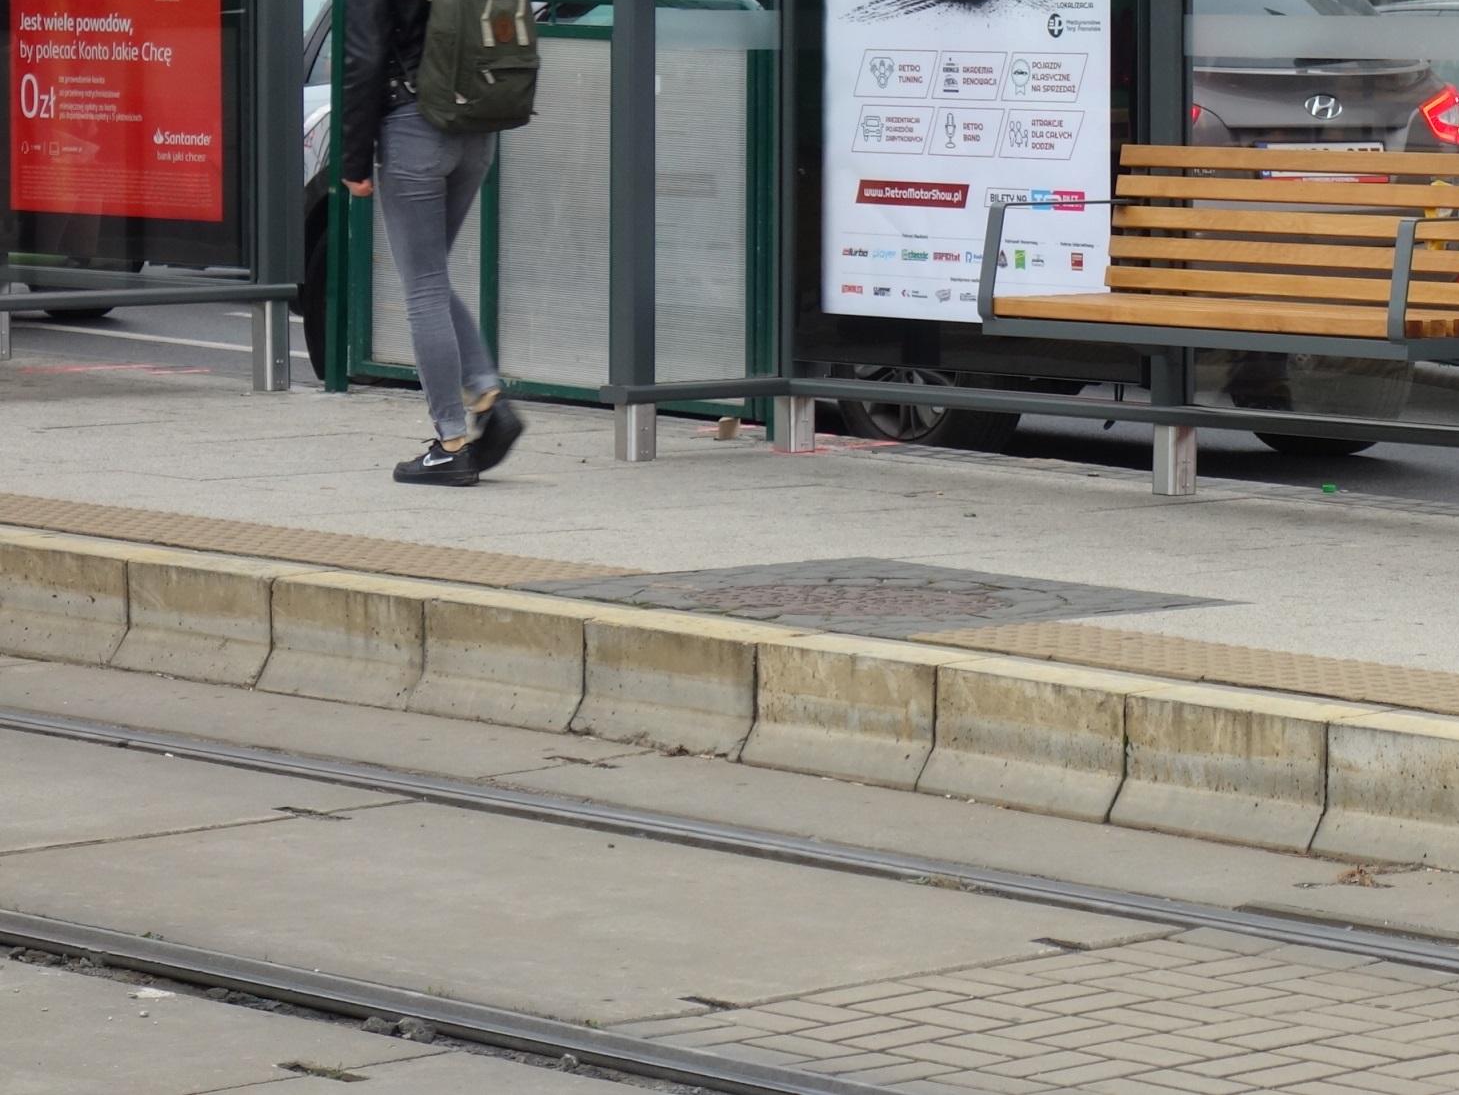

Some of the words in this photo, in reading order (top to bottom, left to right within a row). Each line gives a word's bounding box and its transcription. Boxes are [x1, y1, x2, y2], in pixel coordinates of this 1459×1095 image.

[20, 12, 42, 31] Jest
[44, 12, 73, 31] wiele
[76, 12, 134, 36] powodów,
[20, 40, 33, 63] by
[36, 40, 77, 63] polecać
[78, 42, 109, 59] Konto
[111, 42, 139, 61] Jakie
[141, 42, 172, 66] Chcę
[898, 76, 923, 84] TUNING
[1031, 73, 1071, 82] KLASYCZNE
[164, 131, 212, 146] Santander
[863, 187, 962, 203] www.RetroMotorShow.pl
[990, 194, 1015, 203] BILETY
